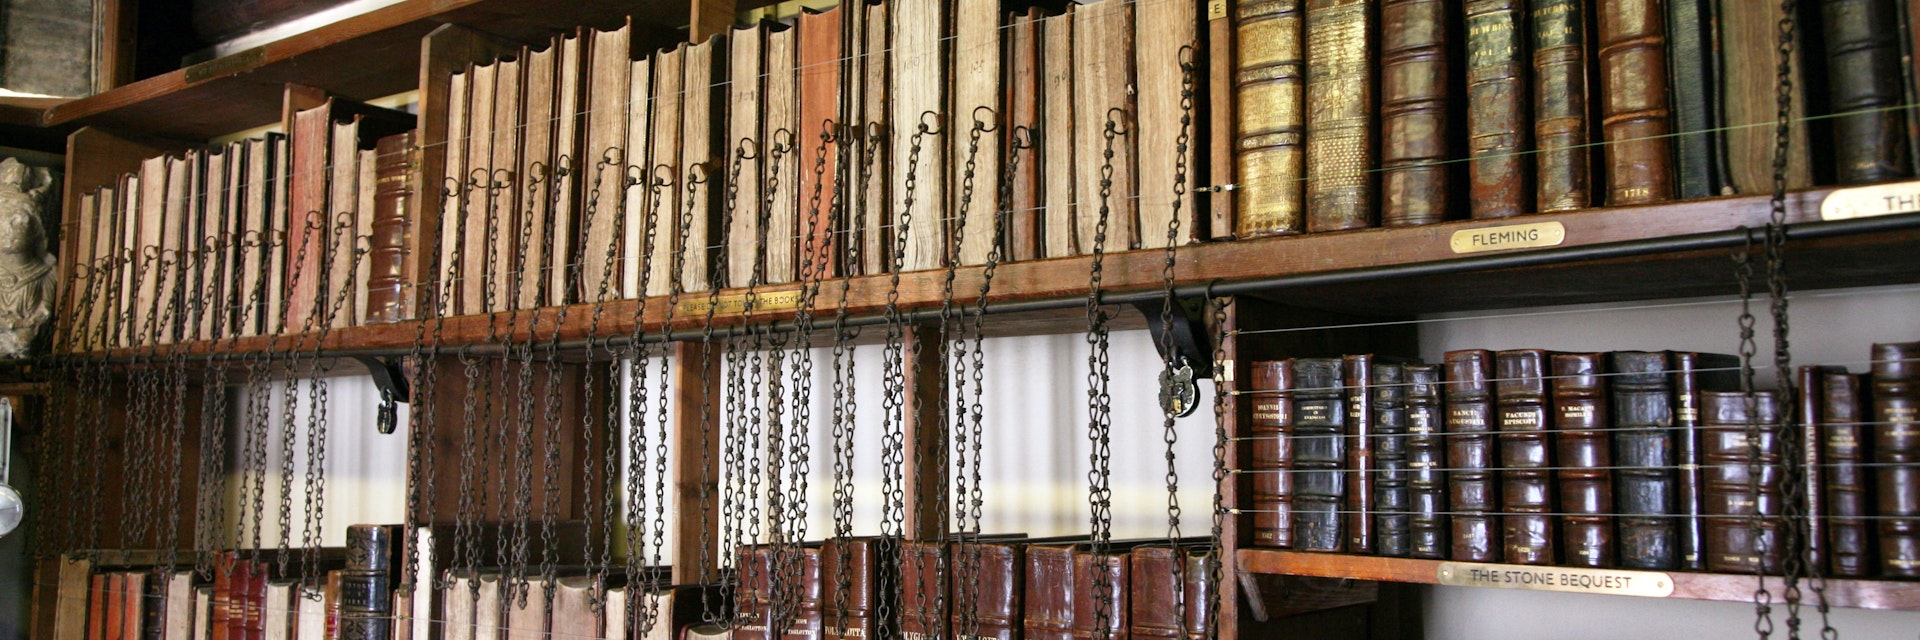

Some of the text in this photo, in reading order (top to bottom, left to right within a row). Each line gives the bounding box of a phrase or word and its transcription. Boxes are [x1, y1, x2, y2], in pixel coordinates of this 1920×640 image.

[1214, 3, 1221, 14] E
[1883, 193, 1920, 212] TH
[1472, 228, 1538, 246] FLEMING
[1470, 569, 1632, 589] THE STONE BEQUEST
